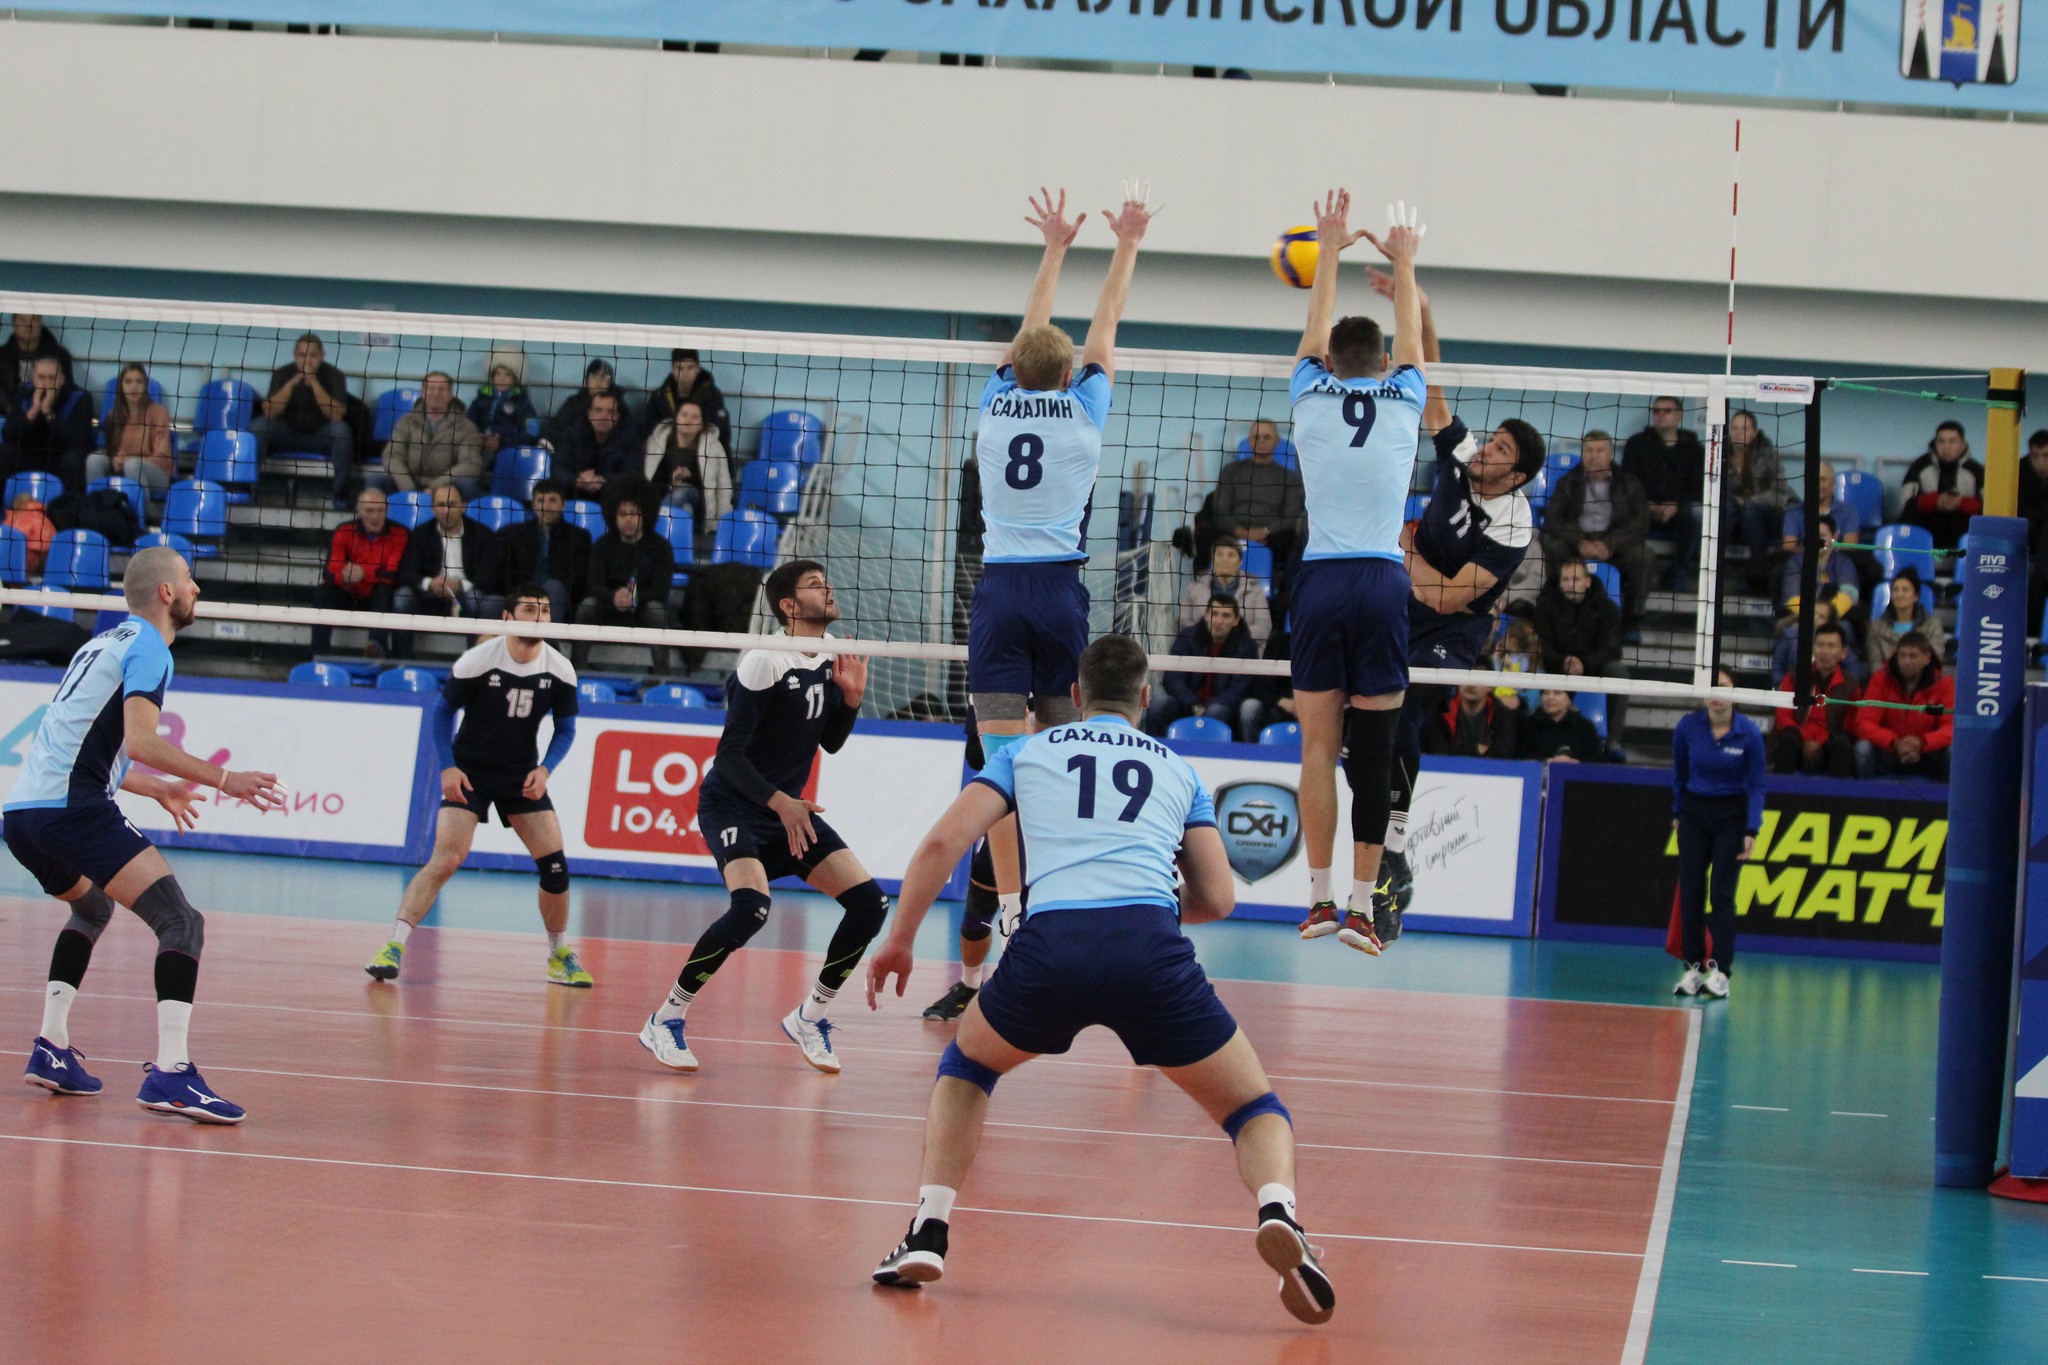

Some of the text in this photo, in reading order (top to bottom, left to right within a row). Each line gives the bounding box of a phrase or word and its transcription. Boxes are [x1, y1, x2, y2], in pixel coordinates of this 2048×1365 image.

[991, 397, 1073, 419] САХАЛИН
[1342, 393, 1377, 448] 9
[1005, 432, 1044, 490] 8
[1980, 554, 2006, 566] FIVB
[1976, 615, 2004, 716] JINLING
[506, 688, 535, 718] 15
[805, 683, 825, 720] 17
[1048, 728, 1168, 759] САХАЛИН
[616, 749, 716, 796] LO
[1067, 753, 1154, 823] 19
[720, 826, 738, 847] 17
